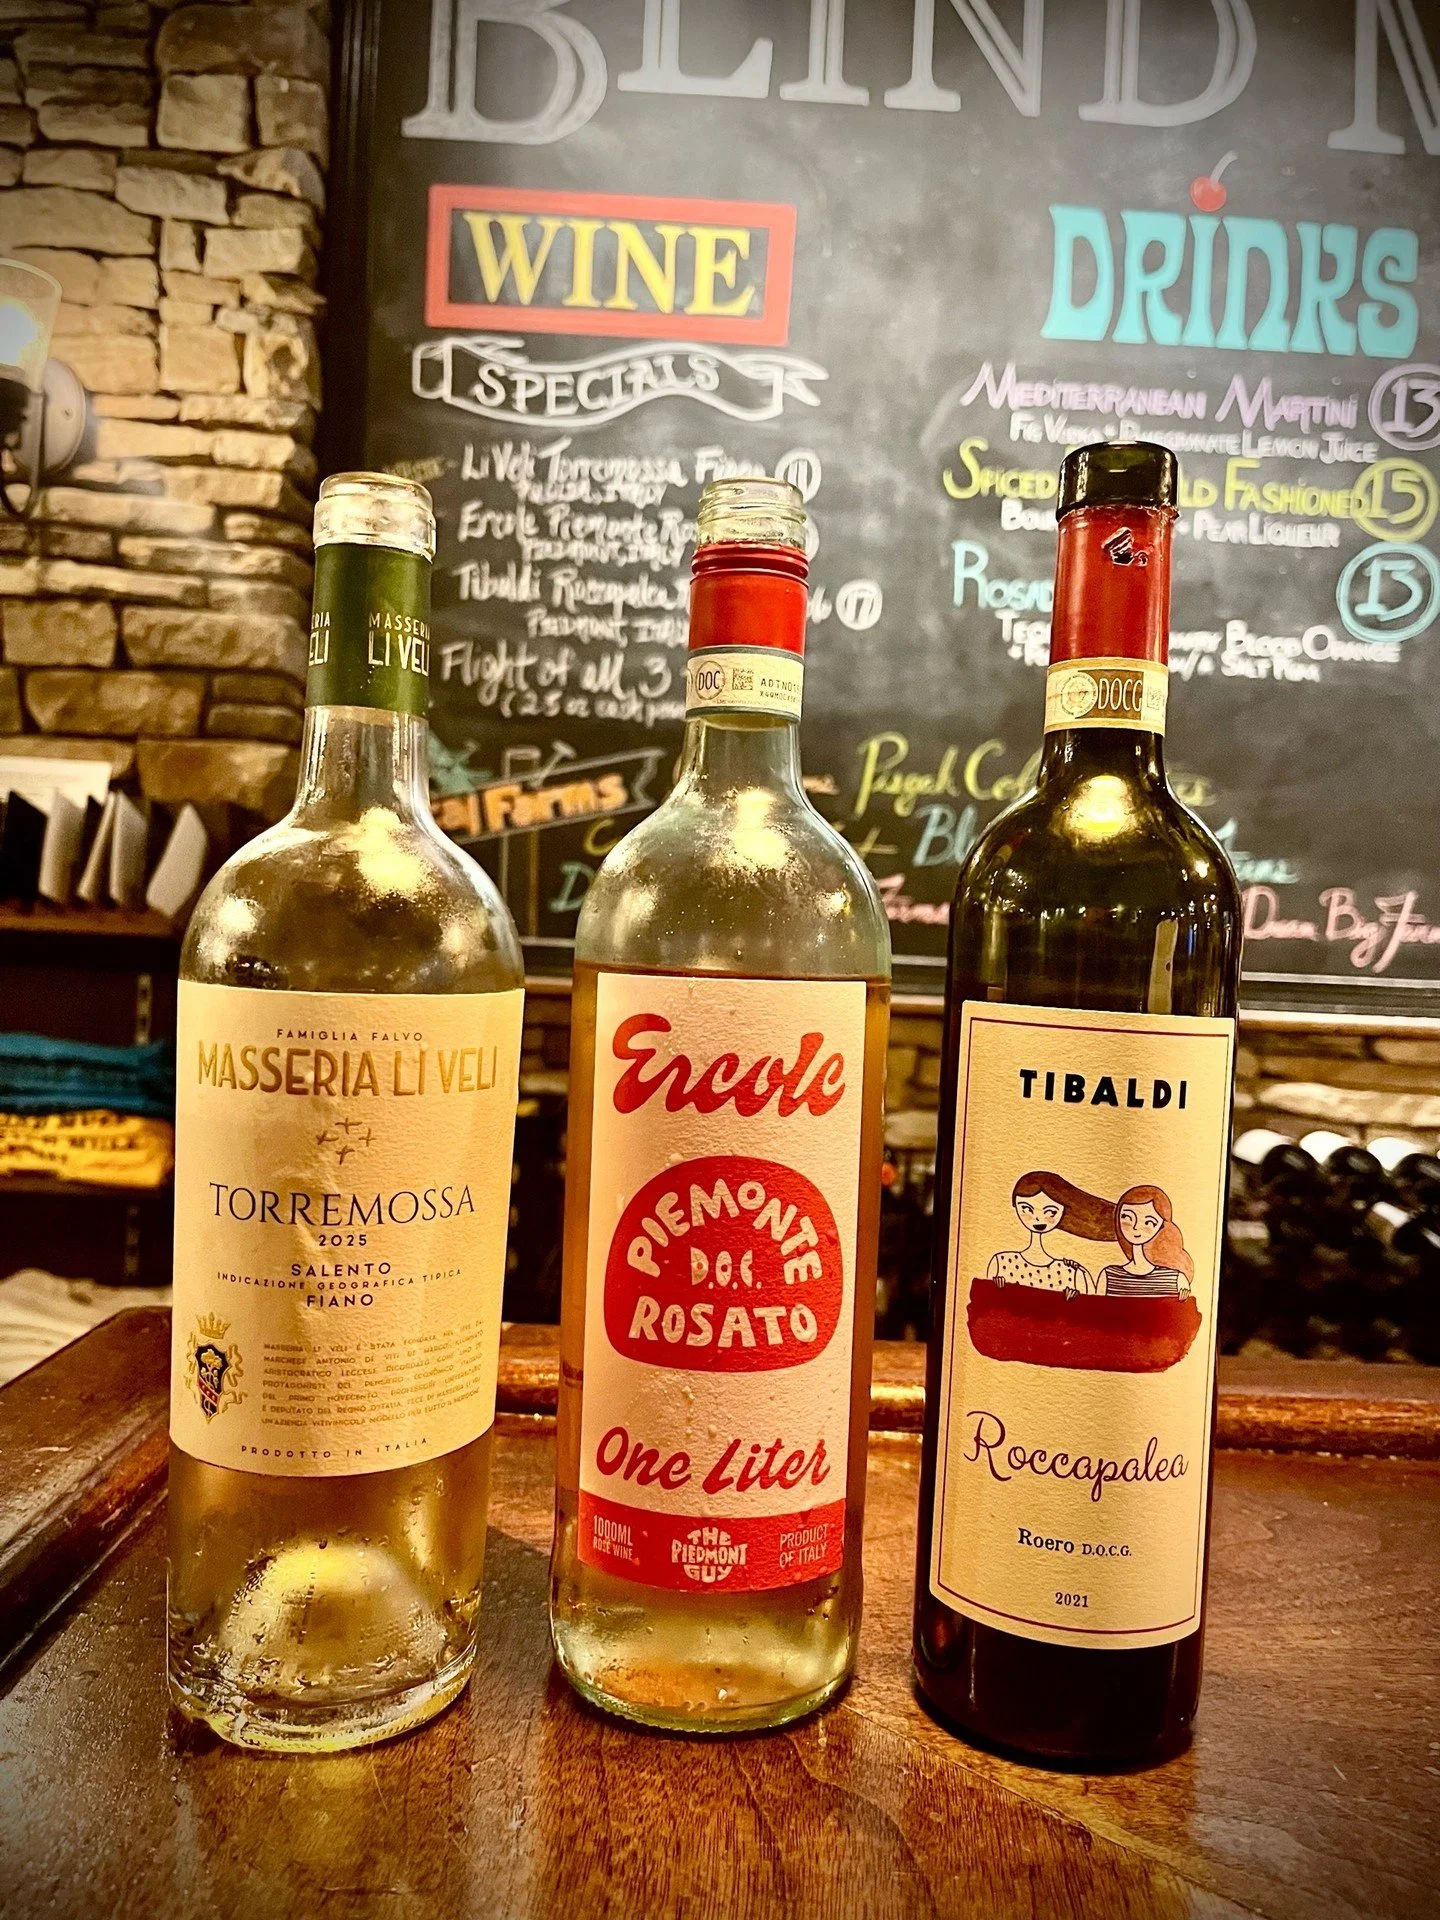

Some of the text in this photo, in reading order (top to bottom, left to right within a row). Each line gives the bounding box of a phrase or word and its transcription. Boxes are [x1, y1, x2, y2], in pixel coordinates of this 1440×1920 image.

[463, 209, 760, 317] WINE
[1041, 203, 1419, 358] DRINKS
[471, 355, 721, 416] SPECIALS
[1368, 468, 1425, 524] 15
[1354, 556, 1423, 622] 13
[698, 670, 721, 691] DOC
[1097, 677, 1143, 712] DOCG
[277, 1029, 423, 1042] FAMIGLIA FALVO
[198, 1039, 498, 1097] MASSERIA LI VELI
[612, 1012, 846, 1117] Ercole
[1019, 1069, 1187, 1110] TIBALDI
[209, 1182, 475, 1227] TORREMOSSA
[318, 1234, 367, 1248] 2025
[626, 1178, 823, 1286] PIEMONTE
[217, 1268, 462, 1291] INDICAZIONE GEOGRAFICA TIPICA
[291, 1261, 391, 1278] SALENTO
[691, 1246, 762, 1290] D.O.C.
[307, 1293, 374, 1308] FIANO
[628, 1295, 818, 1348] ROSATO
[241, 1437, 428, 1459] PRODOTTO IN ITALIA
[596, 1426, 831, 1495] One Liter
[964, 1410, 1189, 1502] Roccapalea
[593, 1514, 634, 1547] 1000ML
[687, 1527, 732, 1546] THE
[779, 1523, 829, 1550] PRODUCT
[1018, 1528, 1133, 1557] Roero D.O.C.G.
[613, 1543, 633, 1561] WINE
[671, 1539, 748, 1565] PIEDMONT
[779, 1542, 829, 1569] OF ITALY
[683, 1564, 733, 1583] GUY
[1055, 1591, 1090, 1608] 2021
